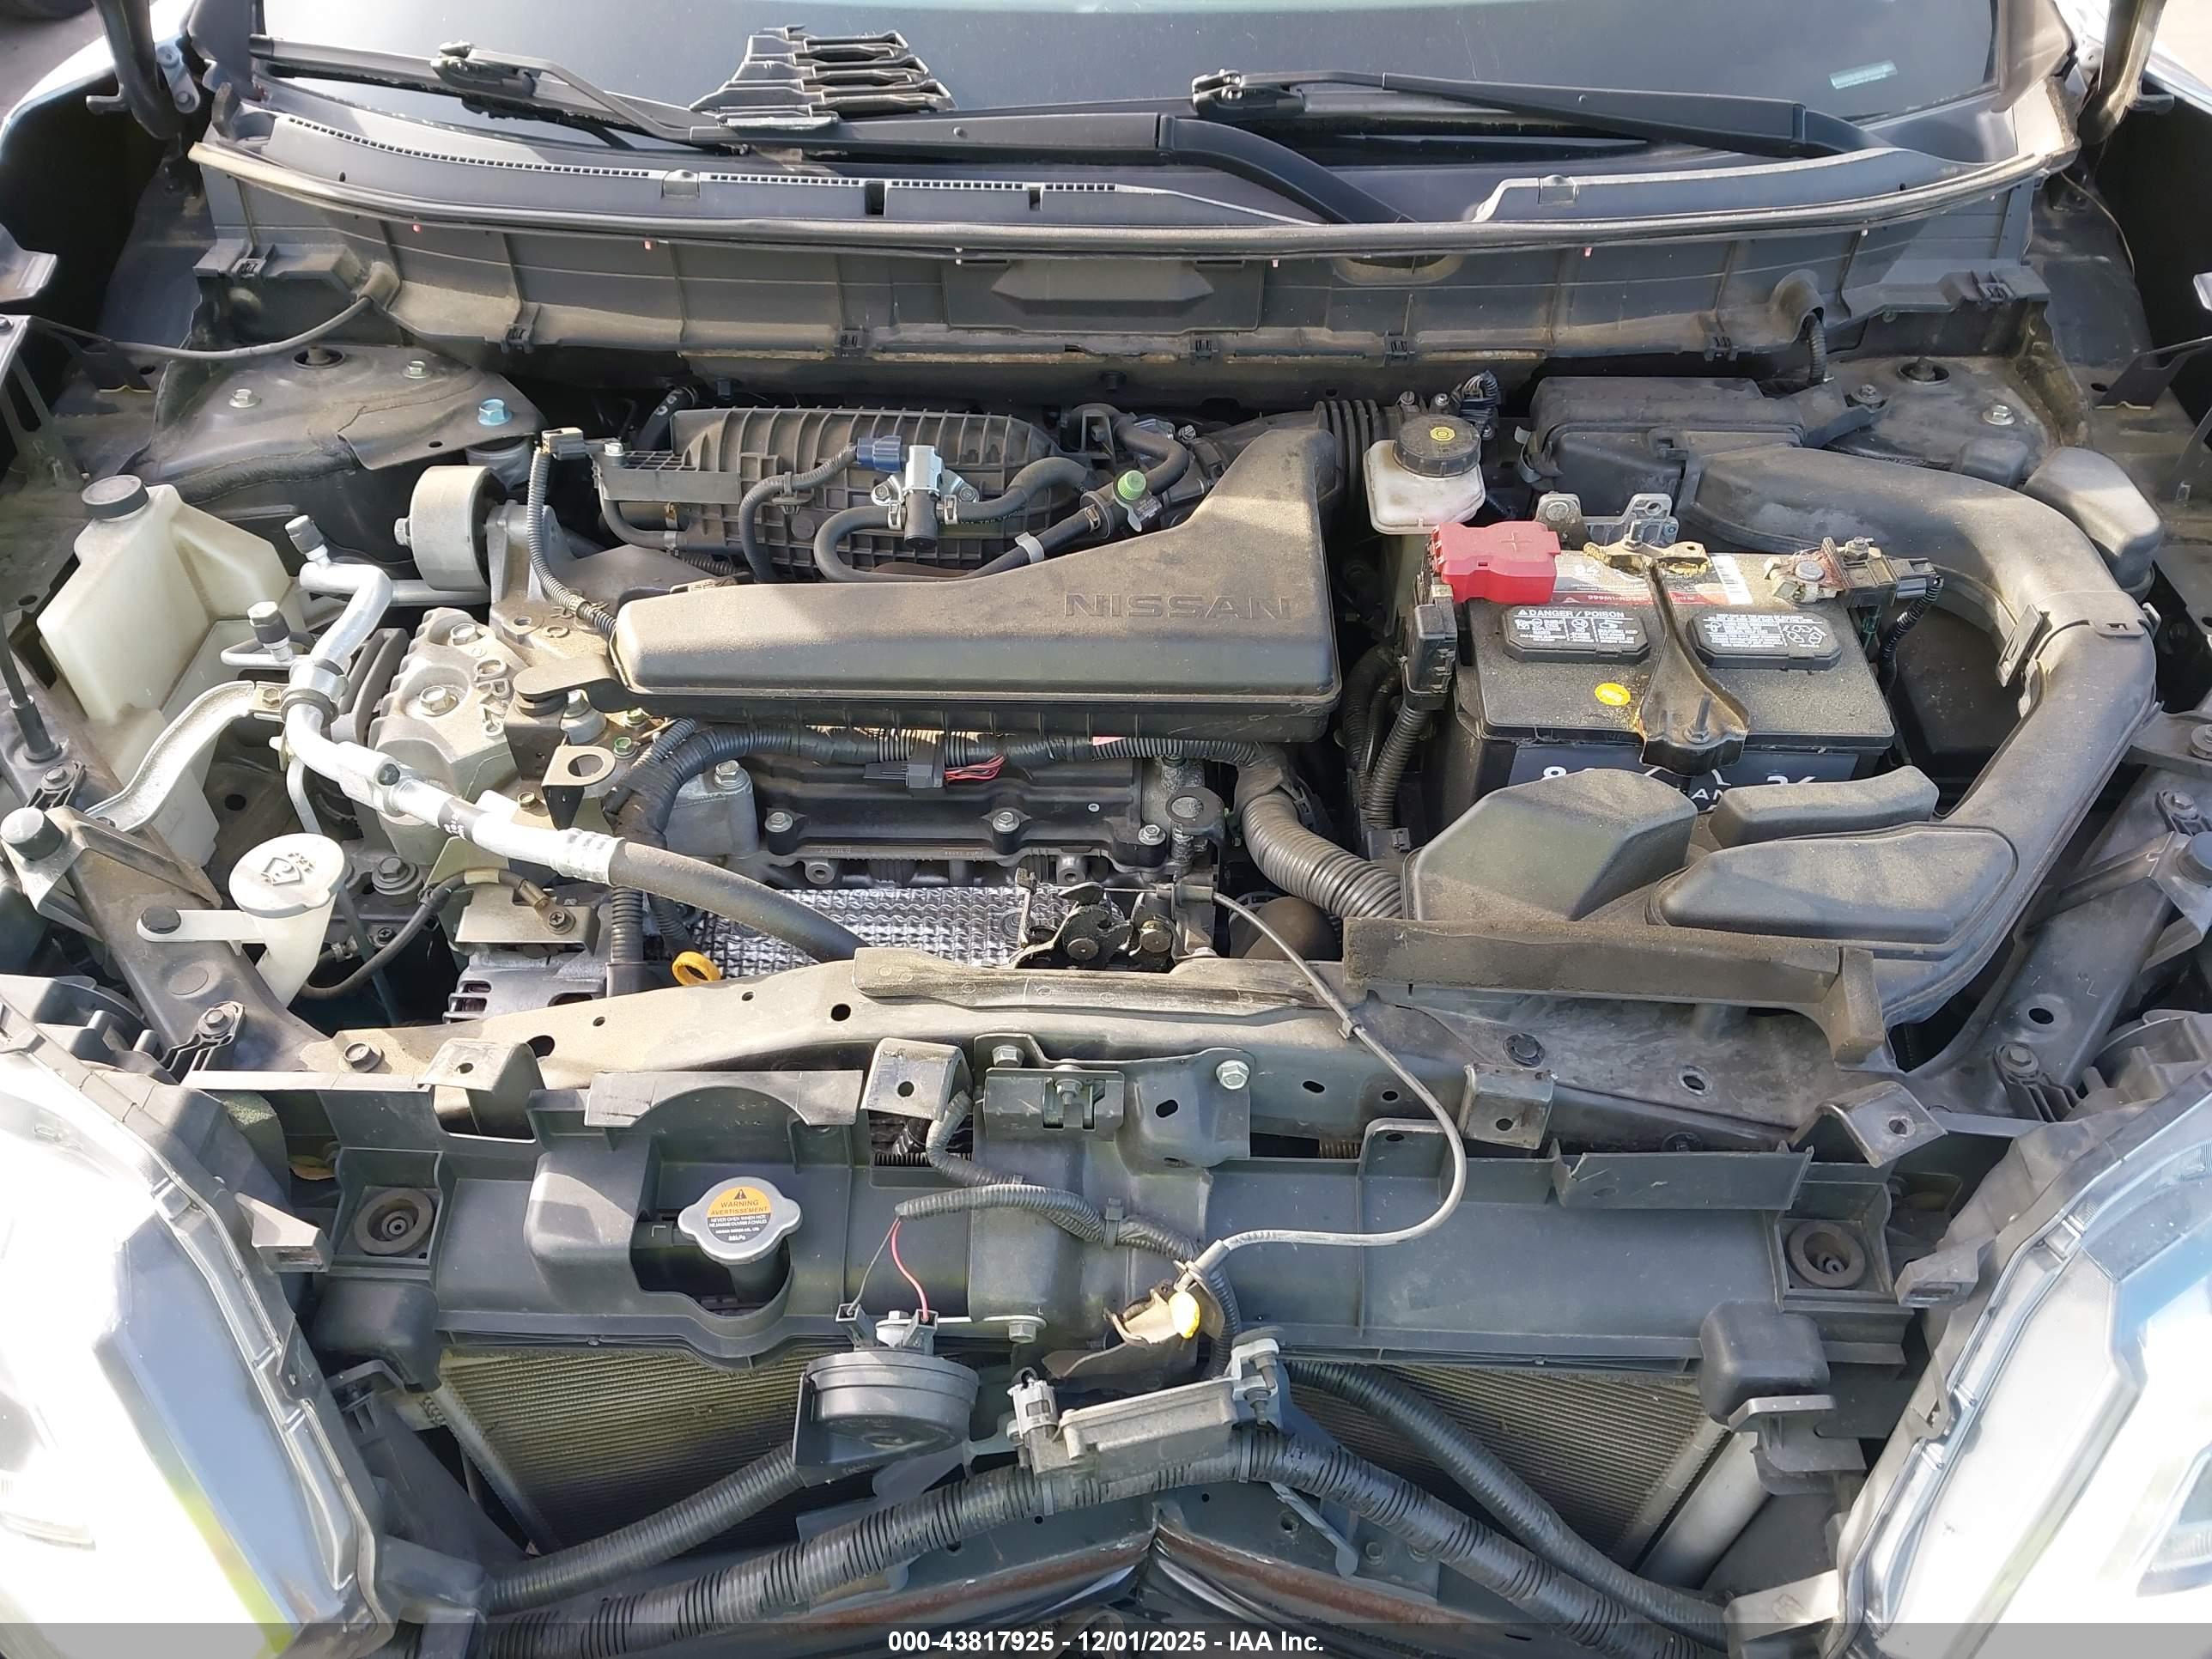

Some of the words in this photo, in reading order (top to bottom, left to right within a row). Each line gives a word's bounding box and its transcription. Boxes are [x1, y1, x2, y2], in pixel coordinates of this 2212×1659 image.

[1063, 592, 1290, 619] NISSAN
[721, 1200, 759, 1208] WARNING
[711, 1206, 768, 1216] AVERTISSEMENT
